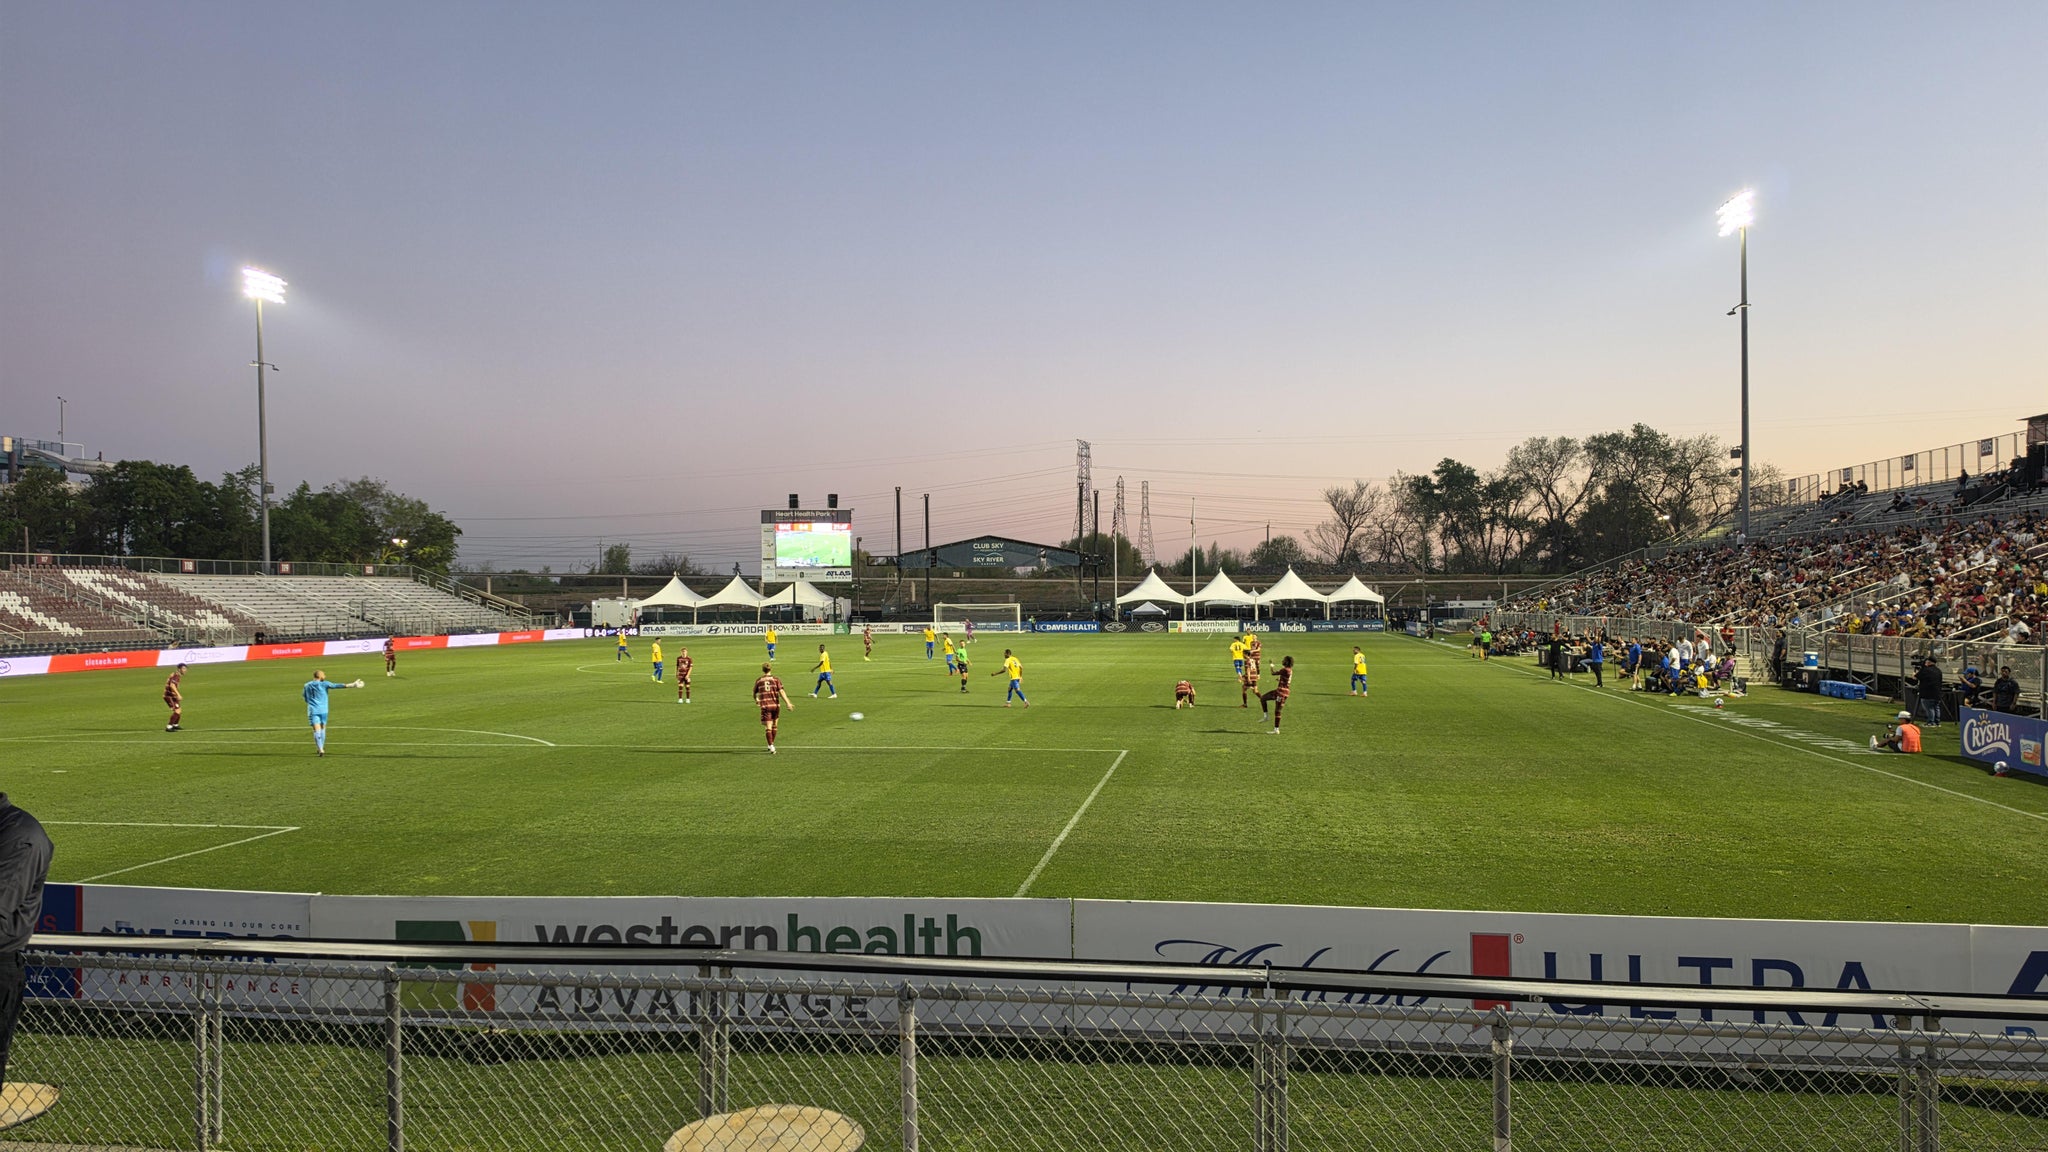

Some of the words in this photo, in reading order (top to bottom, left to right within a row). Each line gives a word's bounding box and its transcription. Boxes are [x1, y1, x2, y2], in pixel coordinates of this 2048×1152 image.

[594, 628, 606, 637] 0-0
[723, 626, 767, 634] HYUNDAI
[1243, 622, 1270, 632] Modelo
[1280, 622, 1306, 632] Modelo
[764, 681, 771, 692] 6
[1963, 719, 2012, 753] CRYSTAL
[174, 918, 216, 928] CARING
[223, 921, 234, 929] IS
[242, 922, 263, 930] OUR
[271, 923, 301, 931] CORE
[118, 972, 301, 995] AMBULANCE
[1543, 952, 1887, 1029] ULTRA
